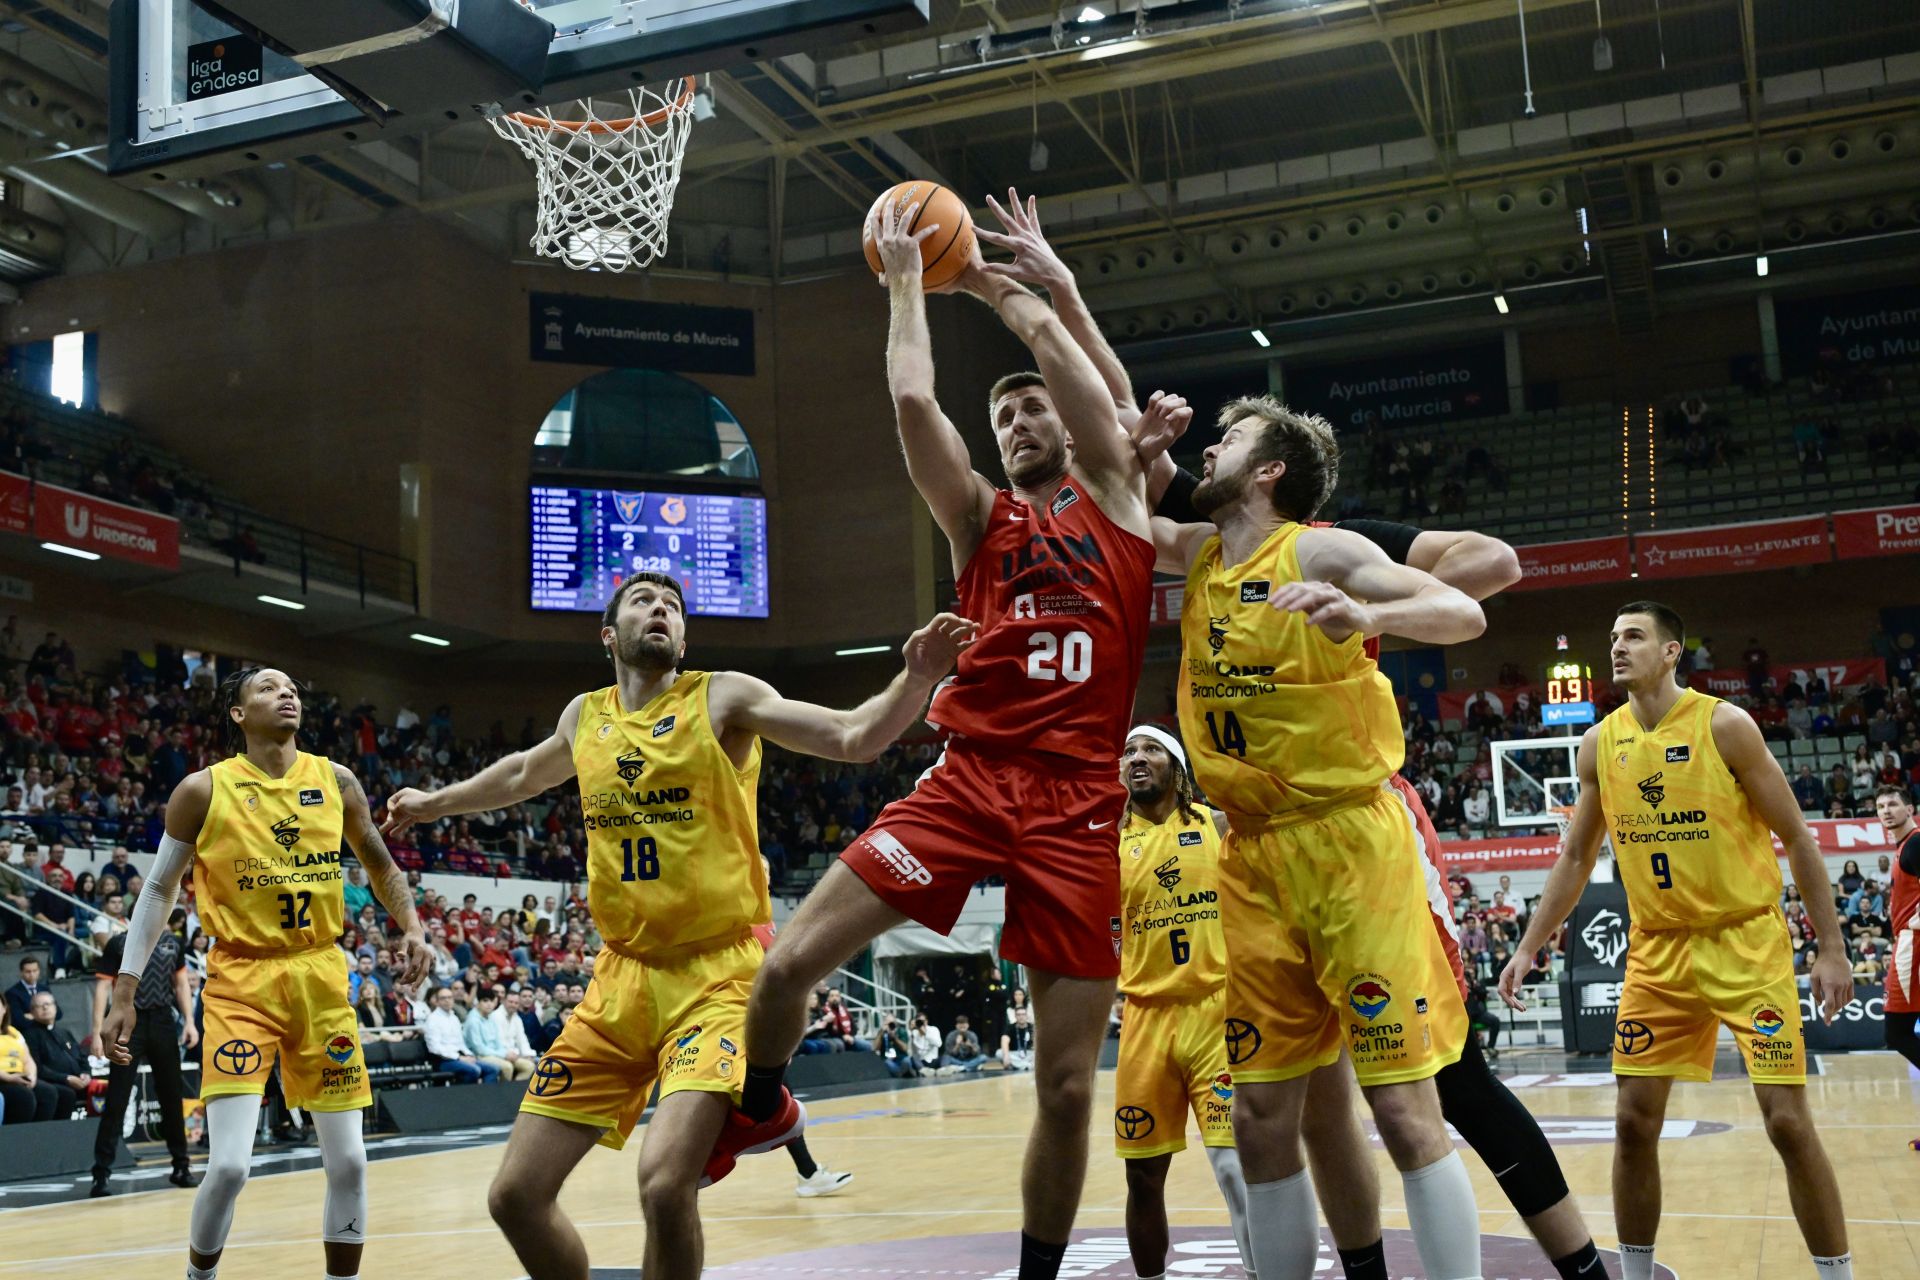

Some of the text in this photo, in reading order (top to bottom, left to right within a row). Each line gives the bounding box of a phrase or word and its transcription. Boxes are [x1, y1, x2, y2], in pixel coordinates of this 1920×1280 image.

[191, 59, 222, 77] liga
[191, 68, 259, 95] endesa
[575, 322, 740, 347] Ayuntamiento de Murcia
[1847, 343, 1875, 361] de
[1329, 367, 1471, 401] Ayuntamiento
[1381, 399, 1453, 420] Murcia
[1876, 513, 1920, 537] Pre
[92, 525, 157, 553] URDECON
[622, 532, 680, 553] 2 0
[1669, 544, 1742, 560] ESTRELLA
[1755, 535, 1821, 552] LEVANTE
[632, 555, 671, 571] 8:28
[1552, 563, 1567, 575] DE
[1570, 558, 1619, 573] MURCIA
[1243, 587, 1256, 596] liga
[1243, 593, 1267, 601] endesa
[1027, 631, 1093, 683] 20
[1191, 682, 1277, 698] GranCanaria
[1548, 679, 1581, 704] 0.9
[1205, 711, 1246, 757] 14
[583, 787, 690, 811] DREAMLAND
[598, 808, 694, 828] GranCanaria
[1629, 828, 1710, 843] GranCanaria
[620, 836, 660, 882] 18
[859, 840, 907, 885] SOLUTIONS
[872, 832, 933, 886] ESP
[1442, 844, 1564, 861] maquinari
[1651, 852, 1673, 890] 9
[277, 891, 312, 929] 32
[1126, 890, 1218, 920] DREAMLAND
[1144, 909, 1218, 930] GranCanaria
[1169, 928, 1191, 966] 6
[1350, 1023, 1403, 1038] Poema
[1354, 1037, 1405, 1053] del Mar
[1751, 1039, 1793, 1049] Poema
[1355, 1052, 1408, 1063] AQUARIUM
[1754, 1050, 1793, 1060] del Mar
[322, 1065, 361, 1078] Poema
[323, 1075, 361, 1087] del Mar
[324, 1086, 362, 1095] AQUARIUM
[1207, 1114, 1221, 1123] del
